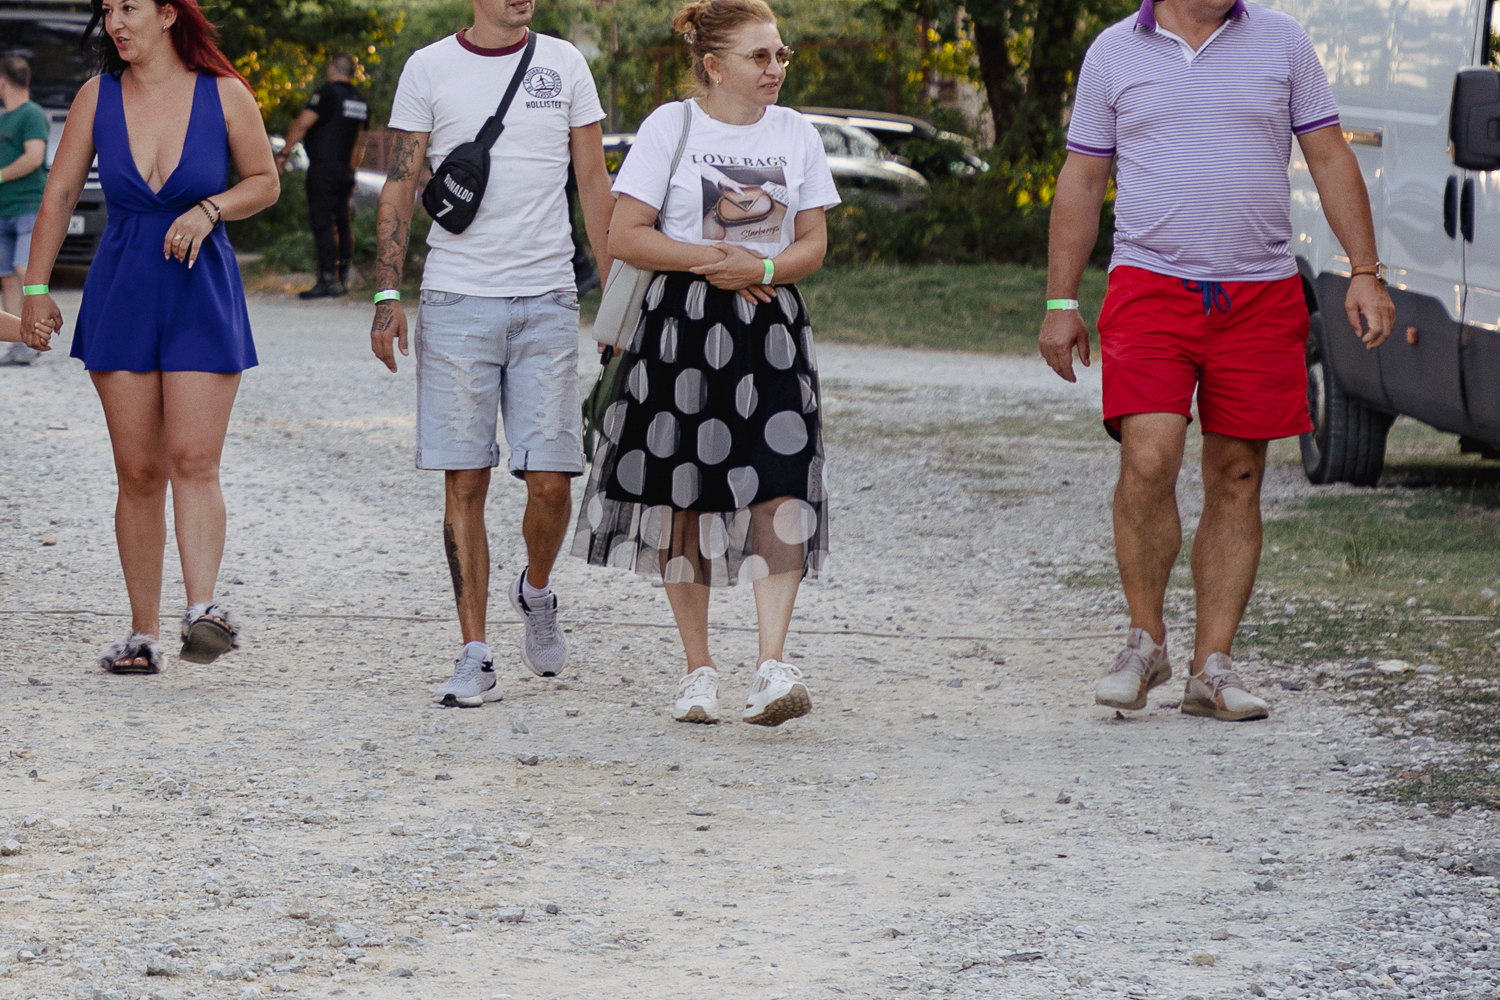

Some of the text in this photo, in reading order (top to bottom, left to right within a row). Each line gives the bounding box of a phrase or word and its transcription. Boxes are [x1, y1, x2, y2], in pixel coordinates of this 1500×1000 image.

[525, 100, 562, 109] HOLLISTER
[691, 153, 788, 167] LOVE BAGS
[436, 198, 454, 218] 7
